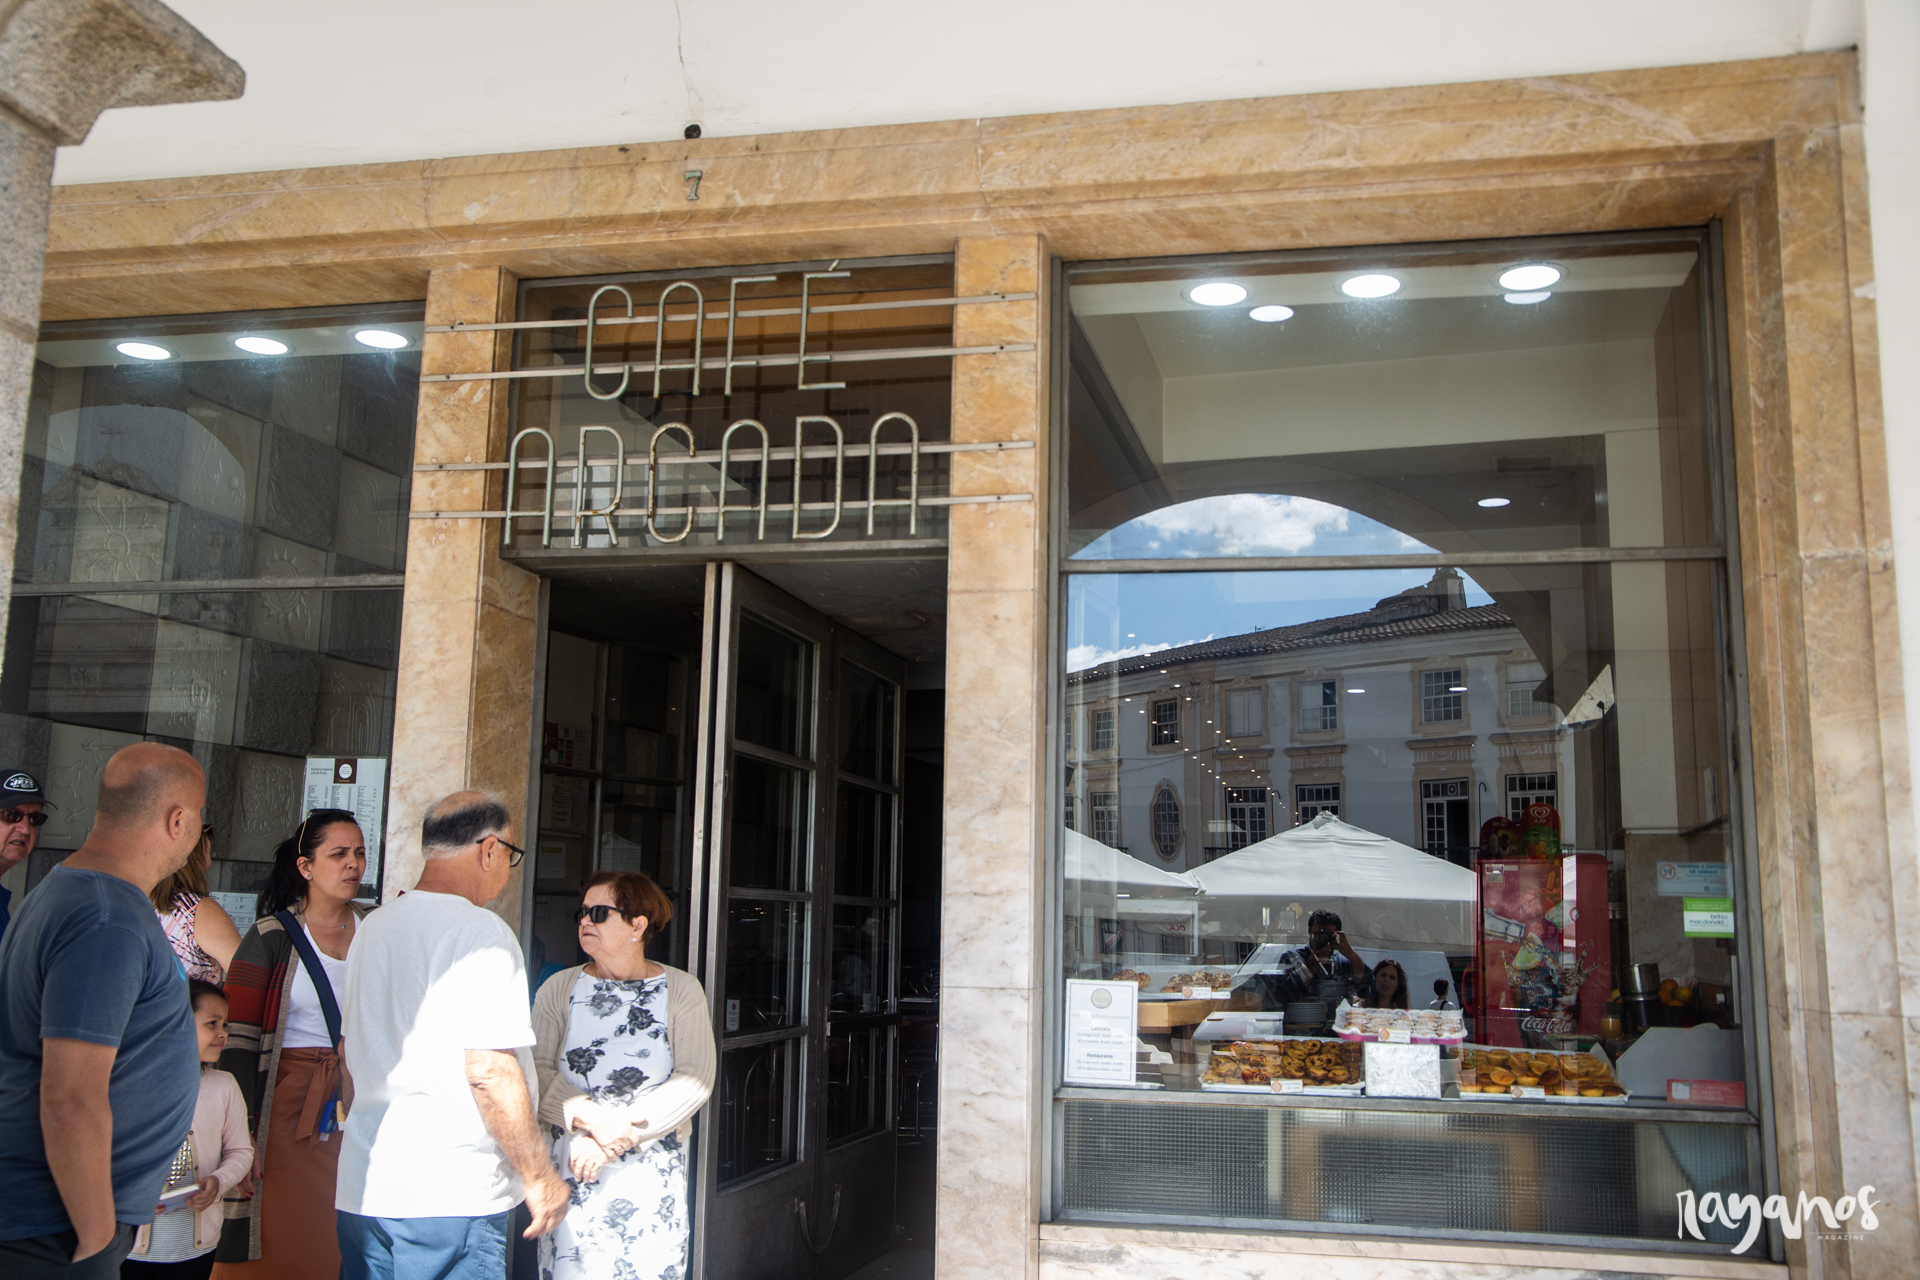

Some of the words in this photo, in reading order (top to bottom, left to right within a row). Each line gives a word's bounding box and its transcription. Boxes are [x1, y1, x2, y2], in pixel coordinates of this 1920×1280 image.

[685, 170, 702, 200] 7
[584, 259, 851, 400] CAFÉ
[504, 411, 919, 547] ARCADA
[1521, 1014, 1573, 1034] Coca-Cola
